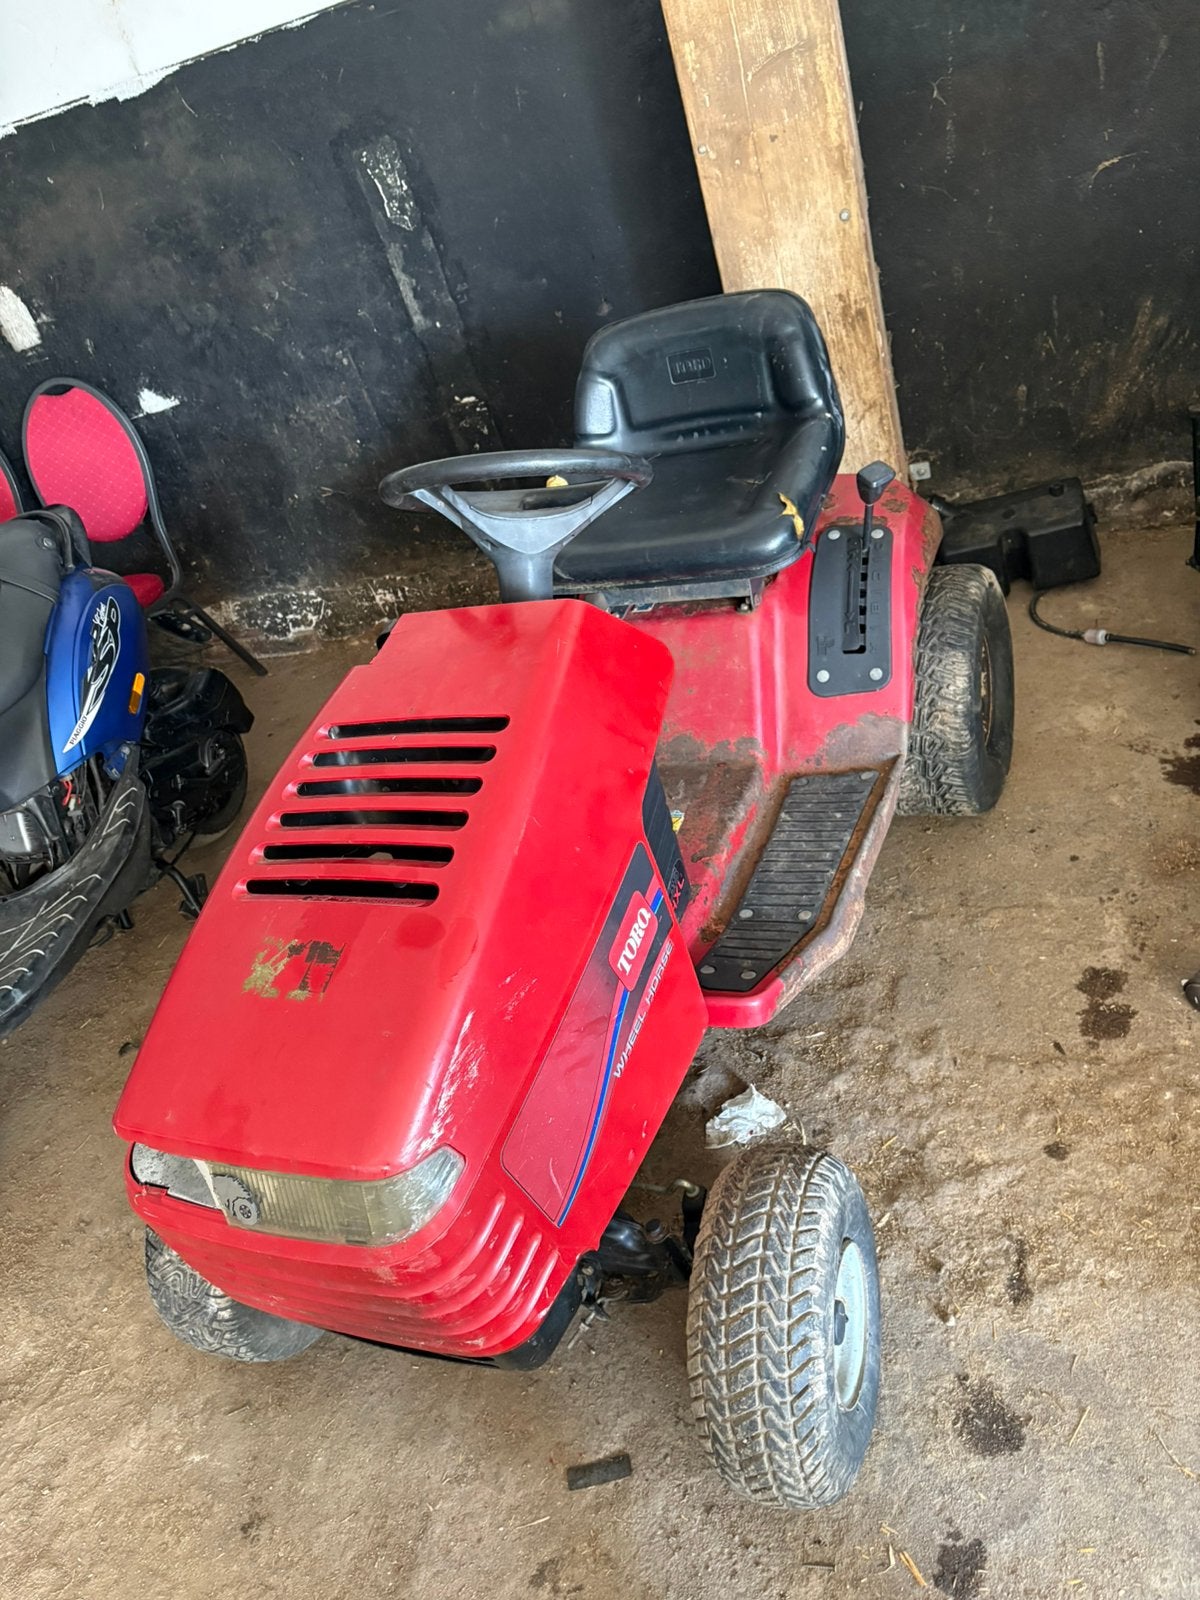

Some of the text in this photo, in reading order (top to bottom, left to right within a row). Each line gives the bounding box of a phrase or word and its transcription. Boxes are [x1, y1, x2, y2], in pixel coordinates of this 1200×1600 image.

[69, 715, 88, 746] PIAGGIO
[617, 907, 652, 976] TORO
[613, 938, 675, 1078] WHEEL HORSE
